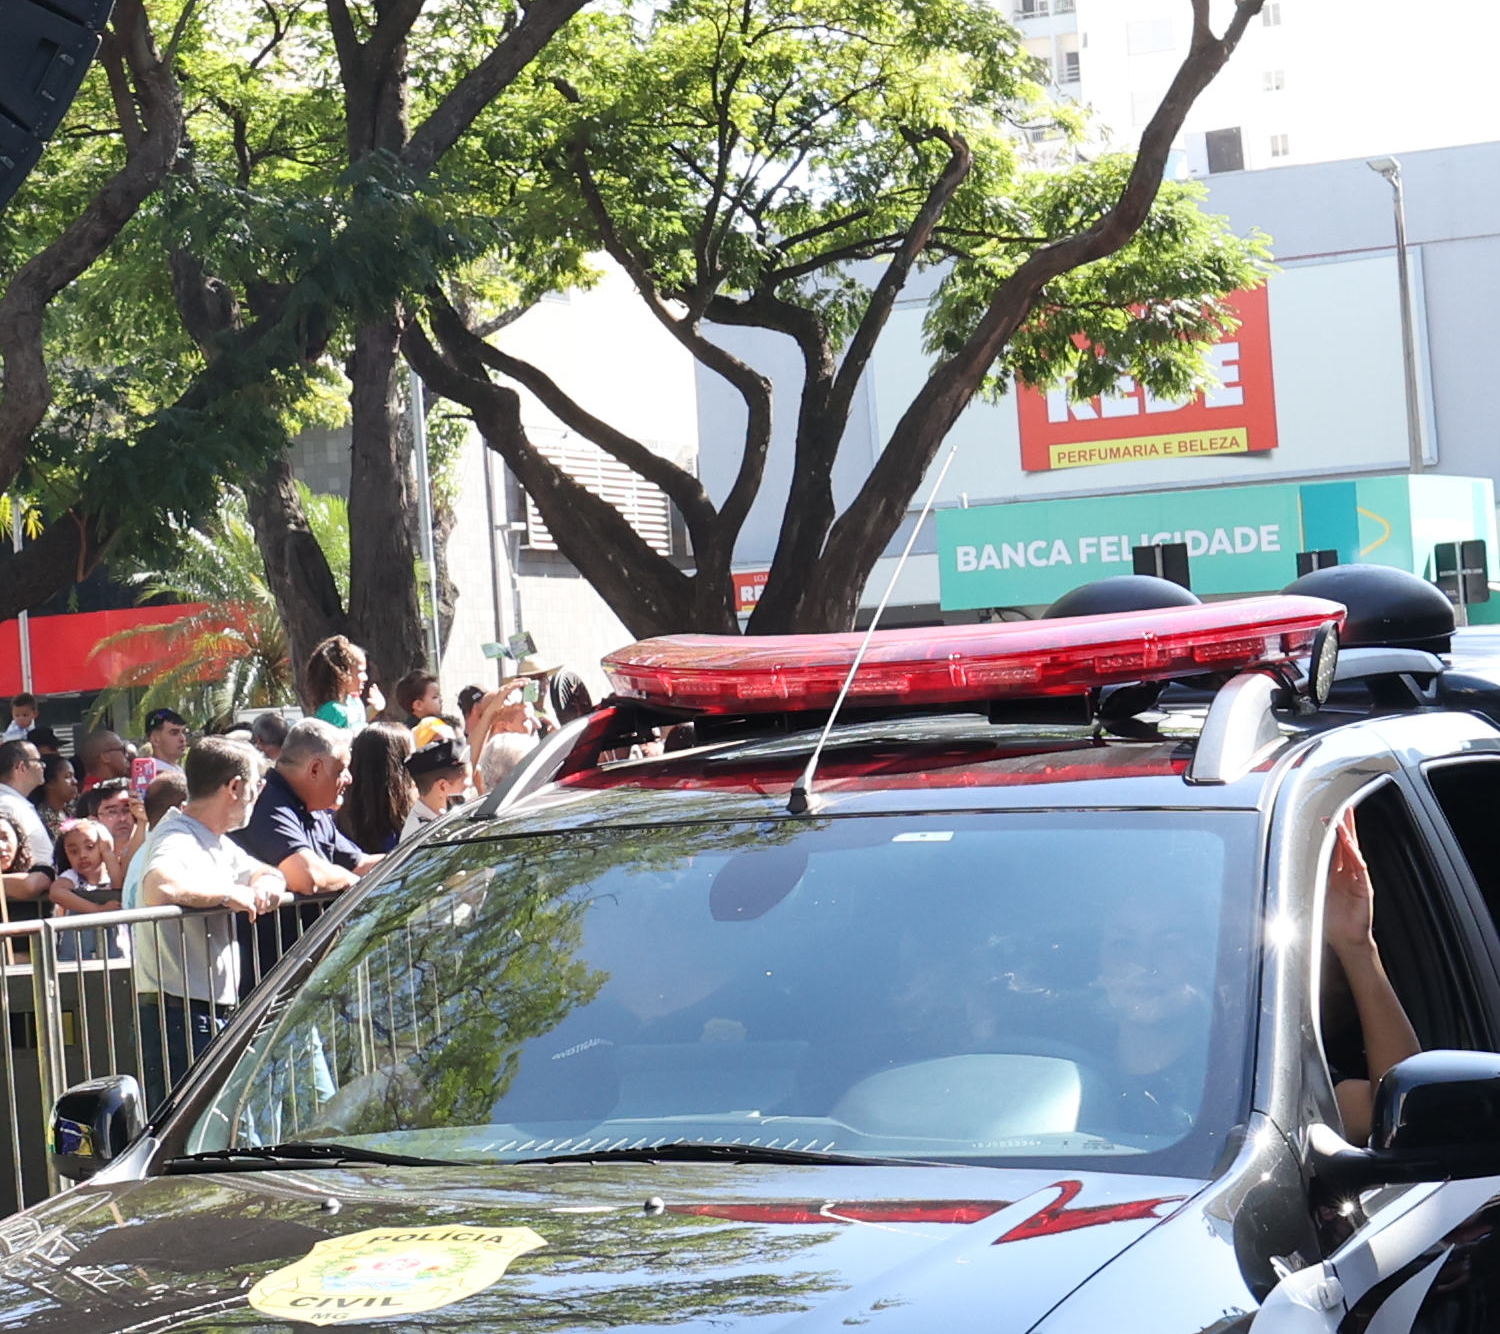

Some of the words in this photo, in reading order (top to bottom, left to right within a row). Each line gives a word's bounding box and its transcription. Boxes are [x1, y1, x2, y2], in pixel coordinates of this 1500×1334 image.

[1057, 443, 1159, 464] PERFUMARIA
[1163, 441, 1173, 454] E
[1178, 436, 1241, 454] BELEZA
[956, 539, 1073, 572] BANCA
[367, 1230, 504, 1245] POLÍCIA
[289, 1296, 405, 1309] CIVIL
